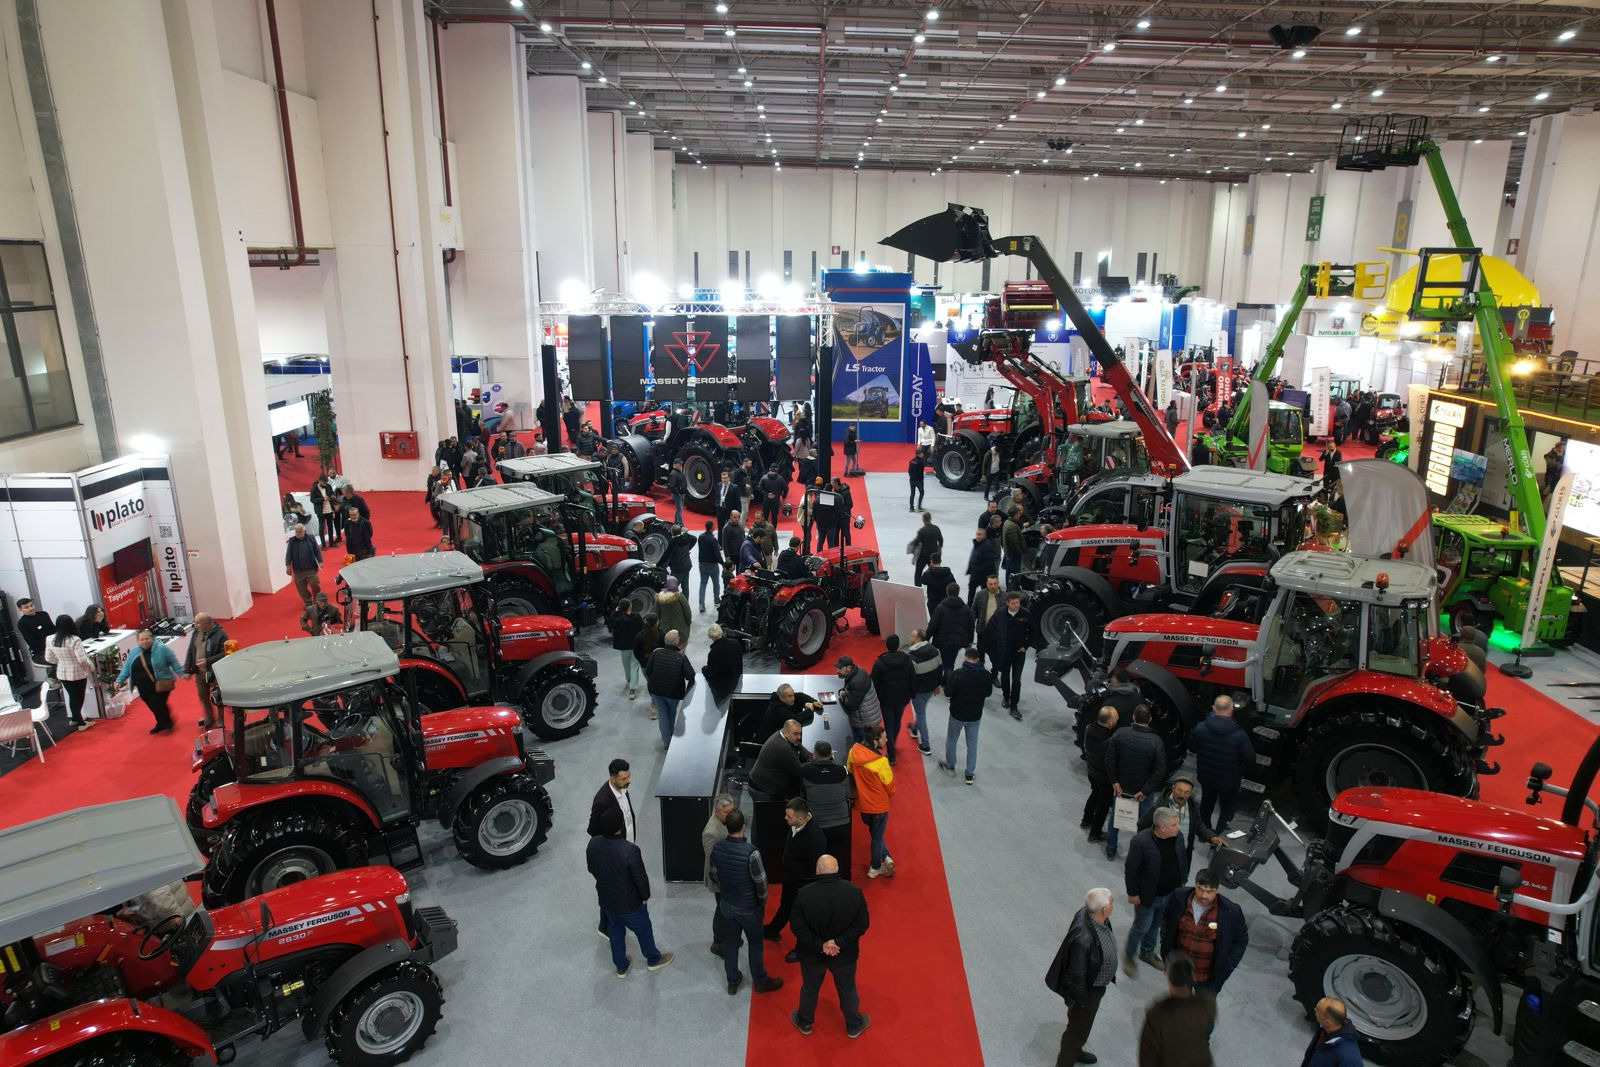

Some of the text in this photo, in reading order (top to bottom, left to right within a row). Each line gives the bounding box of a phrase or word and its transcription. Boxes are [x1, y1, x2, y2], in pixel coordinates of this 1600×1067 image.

[640, 377, 685, 385] MASSEY
[845, 364, 886, 373] LS Tractor
[912, 374, 923, 418] CEDAY
[1503, 438, 1518, 485] MERLO
[106, 499, 145, 529] plato
[165, 546, 182, 585] plato
[1197, 636, 1239, 646] FERGUSON
[447, 732, 479, 742] FERGUSON
[1438, 835, 1551, 863] MASSEY FERGUSON
[268, 910, 351, 938] MASSEY FERGUSON
